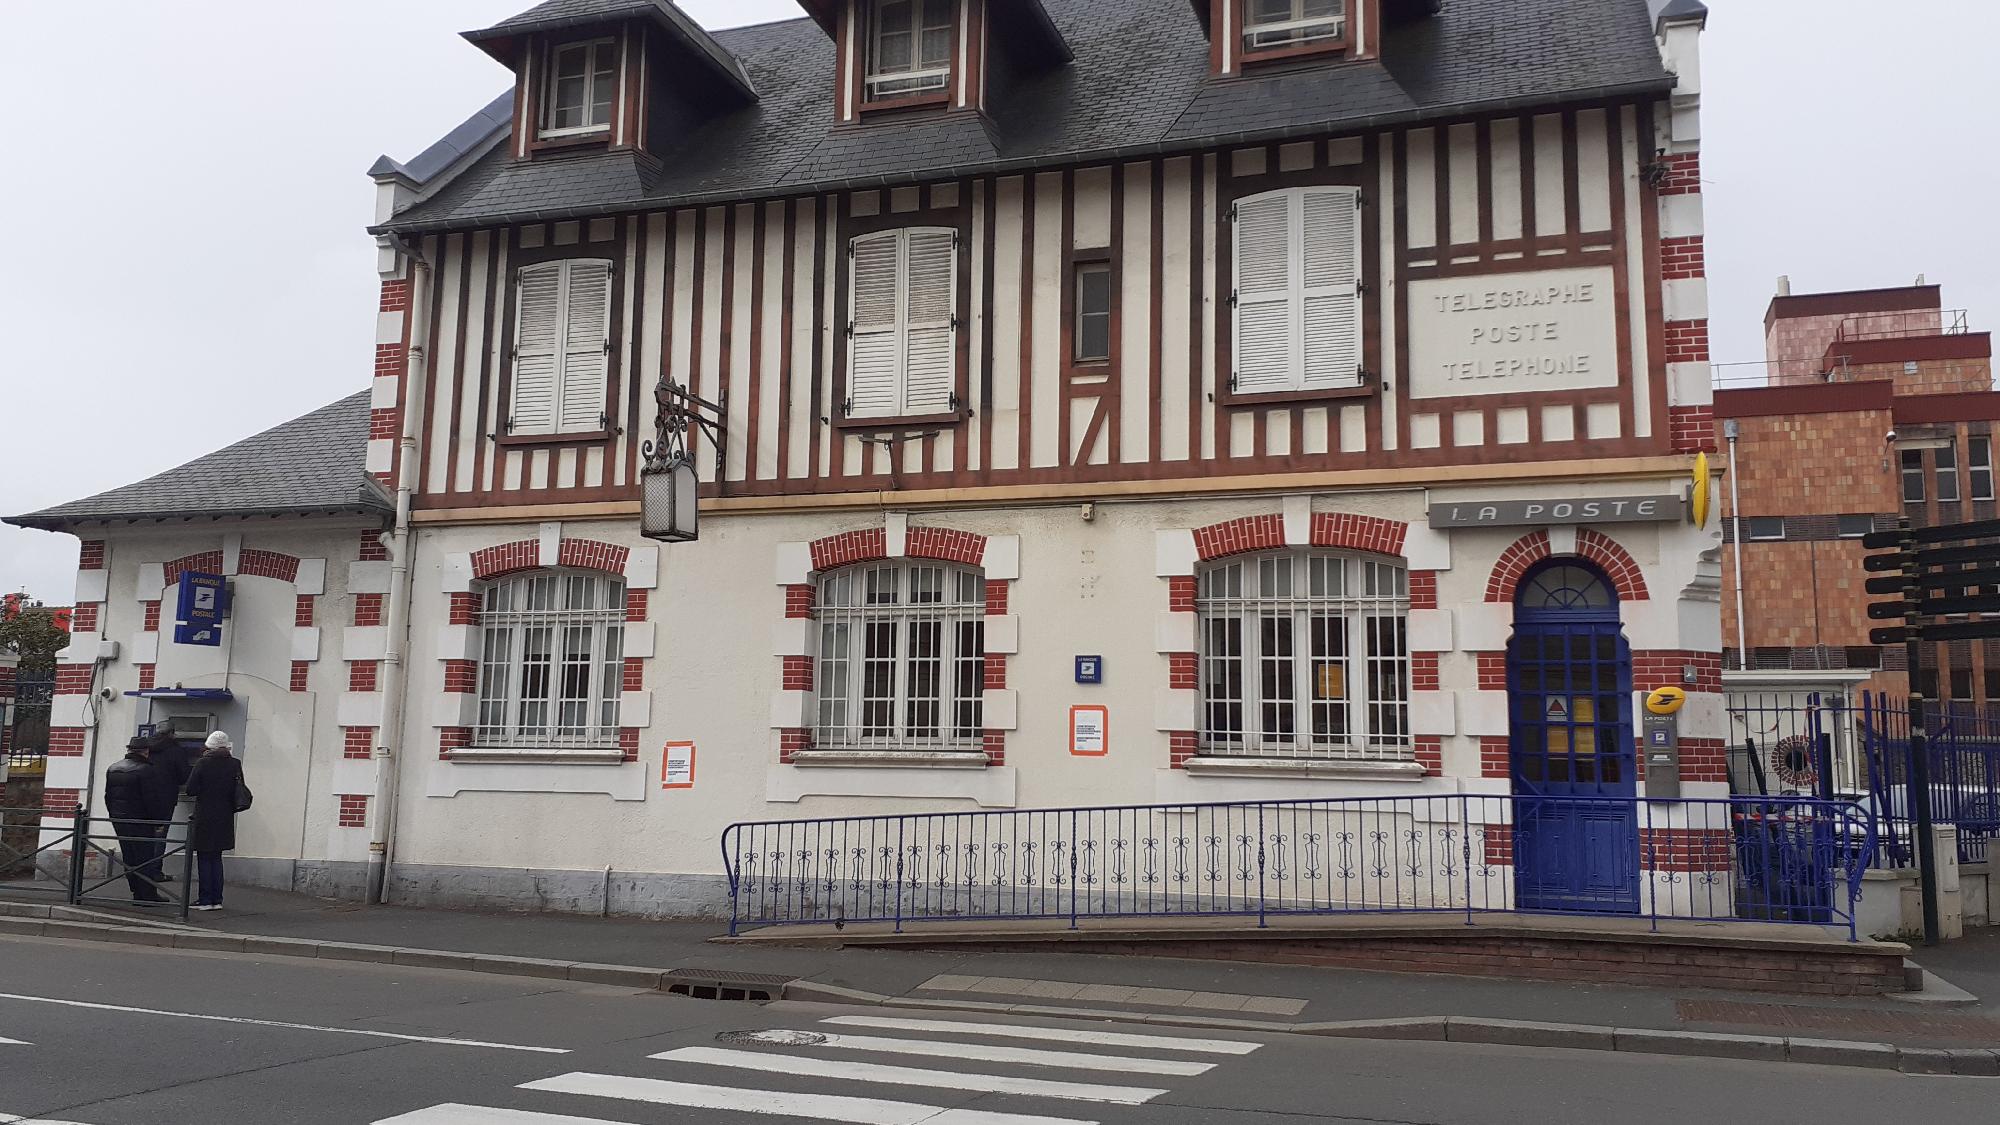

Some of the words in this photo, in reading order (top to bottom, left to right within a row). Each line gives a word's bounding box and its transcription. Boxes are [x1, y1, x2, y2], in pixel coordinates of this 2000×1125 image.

[1434, 284, 1594, 312] TELEGRAPHE
[1470, 322, 1559, 344] POSTE
[1442, 355, 1591, 381] TELEPHONE
[1451, 506, 1497, 521] LA
[1525, 500, 1657, 519] POSTE
